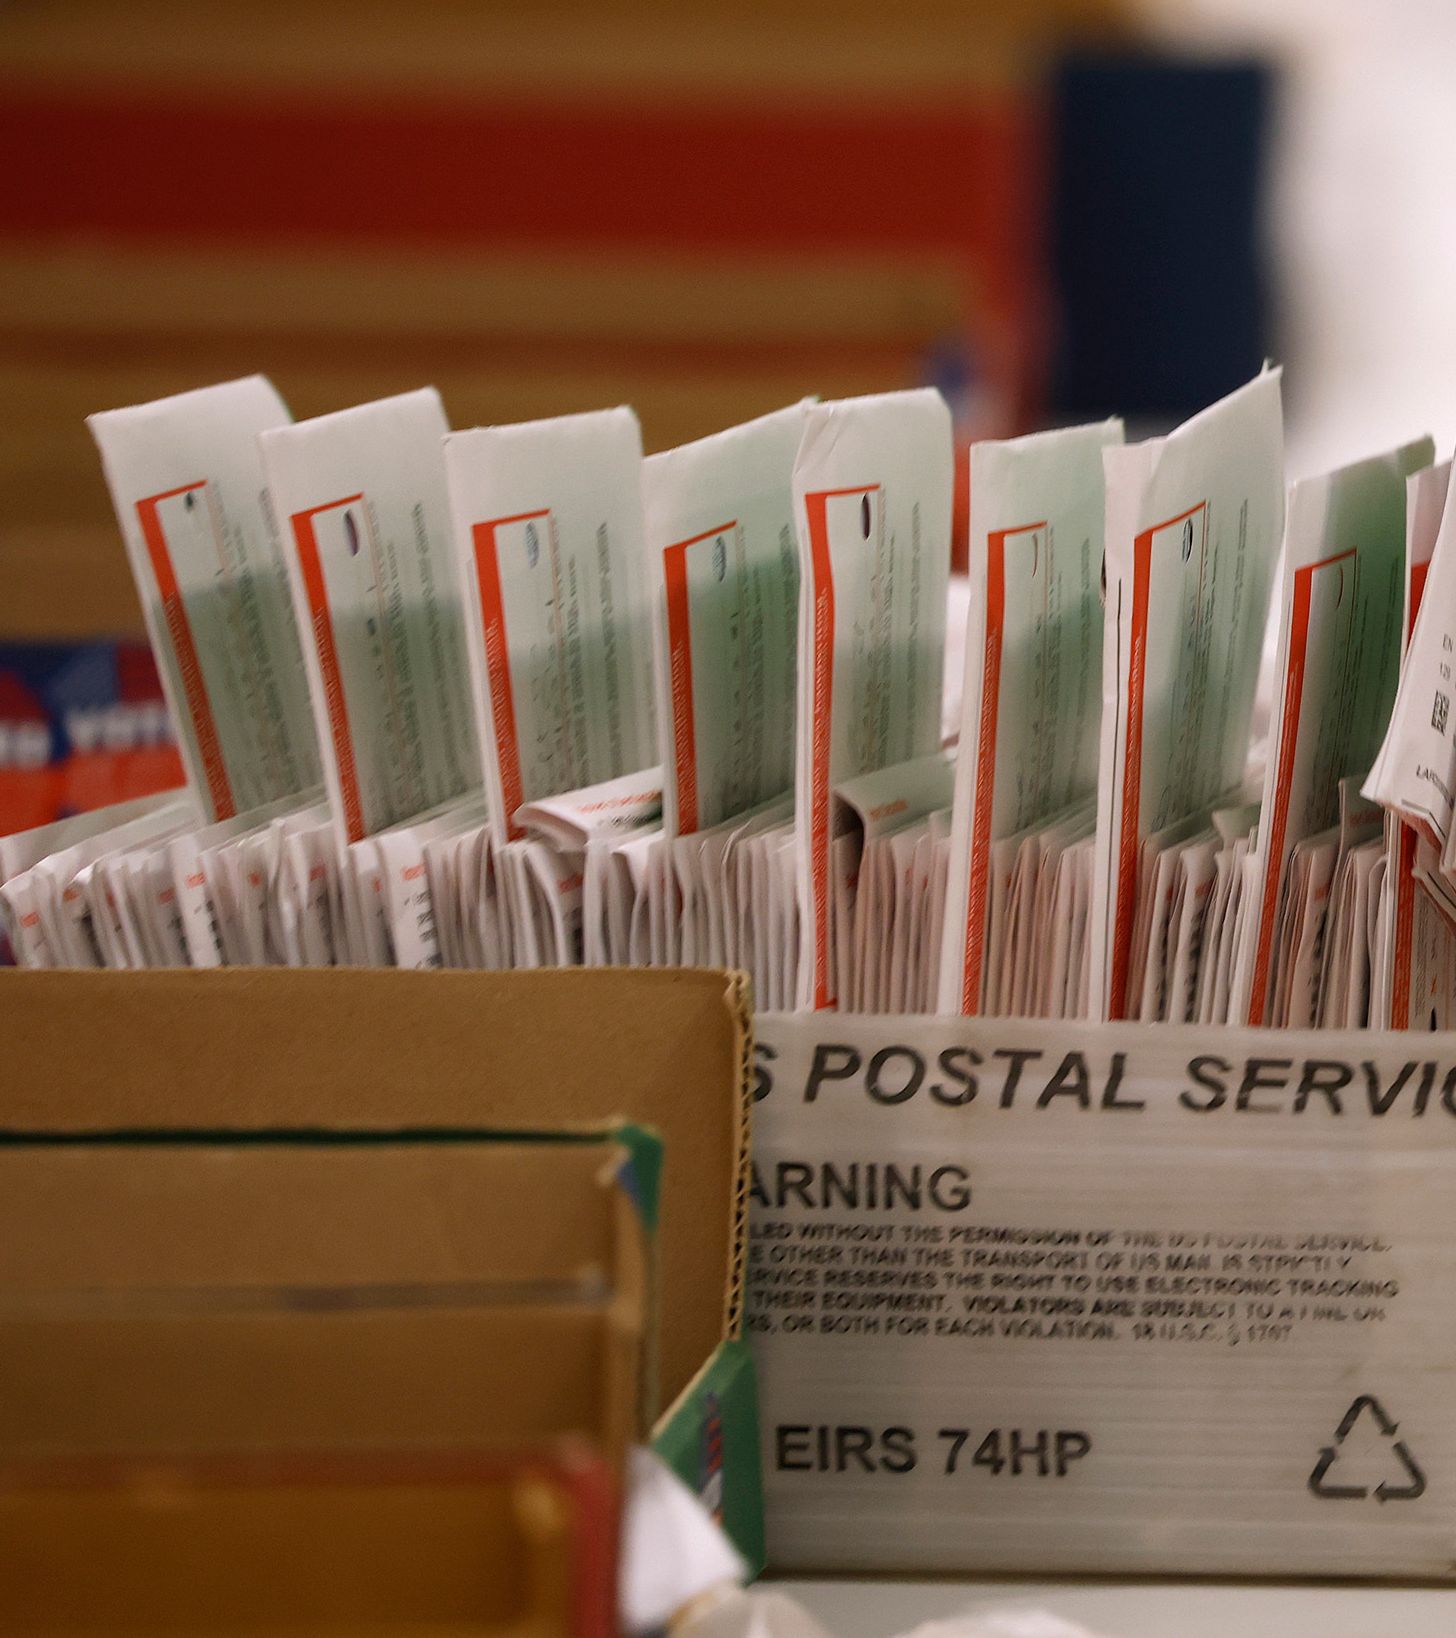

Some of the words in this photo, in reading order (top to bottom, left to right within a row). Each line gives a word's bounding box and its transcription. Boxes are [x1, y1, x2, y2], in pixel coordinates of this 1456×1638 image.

[803, 1043, 1147, 1112] POSTAL
[799, 1222, 895, 1242] WITHOUT
[901, 1225, 944, 1243] THE
[948, 1226, 1080, 1246] PERMISSION
[1085, 1229, 1115, 1247] OF
[769, 1244, 844, 1265] OTHER
[850, 1245, 907, 1265] THAN
[912, 1247, 957, 1267] THE
[961, 1248, 1088, 1270] TRANSPORT
[1094, 1250, 1125, 1270] OF
[1130, 1250, 1161, 1272] US
[1222, 1254, 1243, 1272] IS
[823, 1269, 938, 1289] RESERVES
[942, 1271, 984, 1290] THE
[990, 1272, 1056, 1291] RIGHT
[1060, 1273, 1092, 1293] TO
[1096, 1275, 1141, 1294] USE
[1145, 1276, 1282, 1296] ELECTRONIC
[1287, 1278, 1400, 1299] TRACKING
[752, 1290, 816, 1309] THEIR
[961, 1295, 1086, 1317] VIOLATORS
[1089, 1297, 1136, 1319] ARE
[1140, 1299, 1237, 1320] SUBJECT
[1246, 1302, 1274, 1321] TO
[1278, 1305, 1295, 1321] A
[781, 1314, 815, 1334] OR
[819, 1314, 880, 1335] BOTH
[884, 1315, 930, 1336] FOR
[934, 1316, 994, 1338] EACH
[998, 1317, 1121, 1339] VIOLATION.
[775, 1424, 918, 1474] EIRS
[937, 1427, 1093, 1477] 74HP
